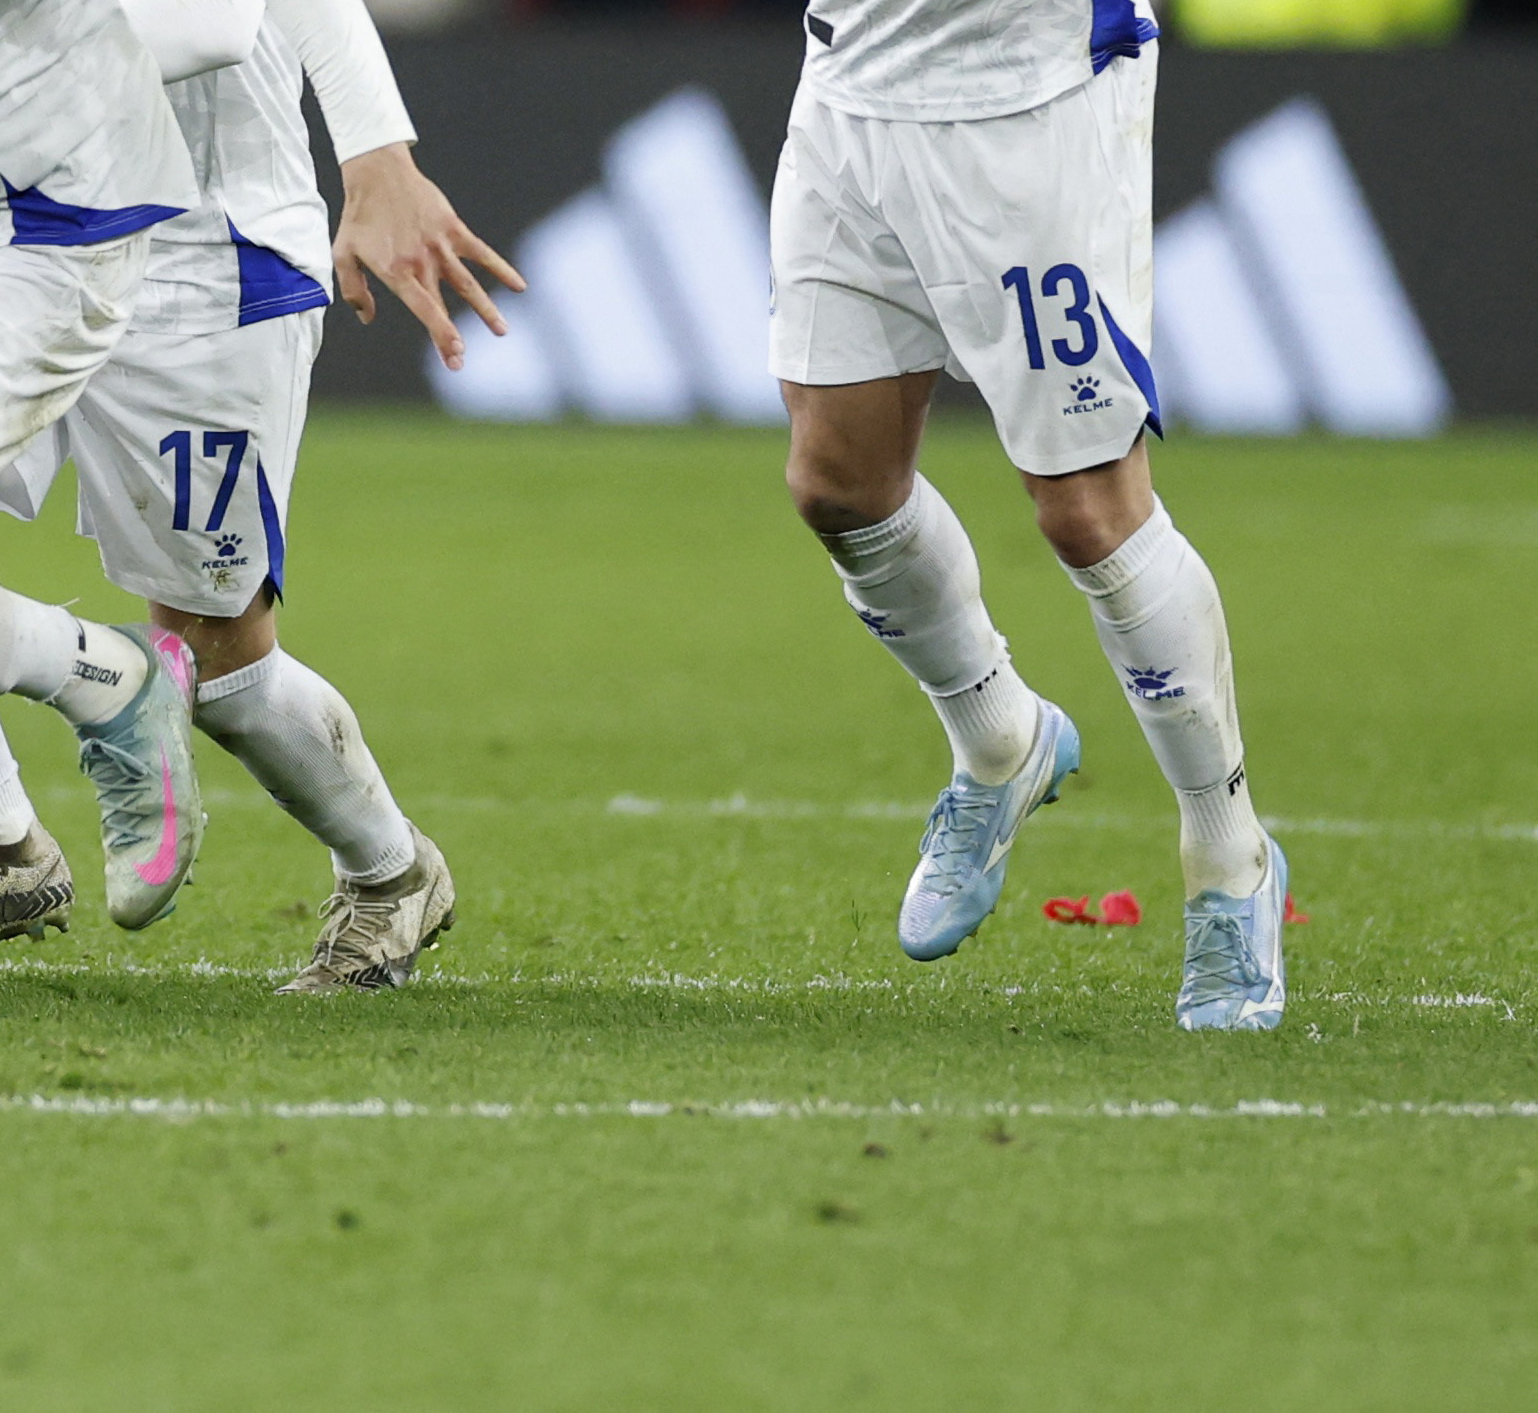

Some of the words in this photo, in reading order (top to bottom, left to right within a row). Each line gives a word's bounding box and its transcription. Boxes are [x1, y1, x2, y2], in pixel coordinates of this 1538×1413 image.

[1002, 263, 1099, 370] 13
[1063, 398, 1113, 416] KELME
[159, 430, 249, 532] 17
[202, 557, 248, 570] KELME
[1125, 681, 1186, 700] KELME
